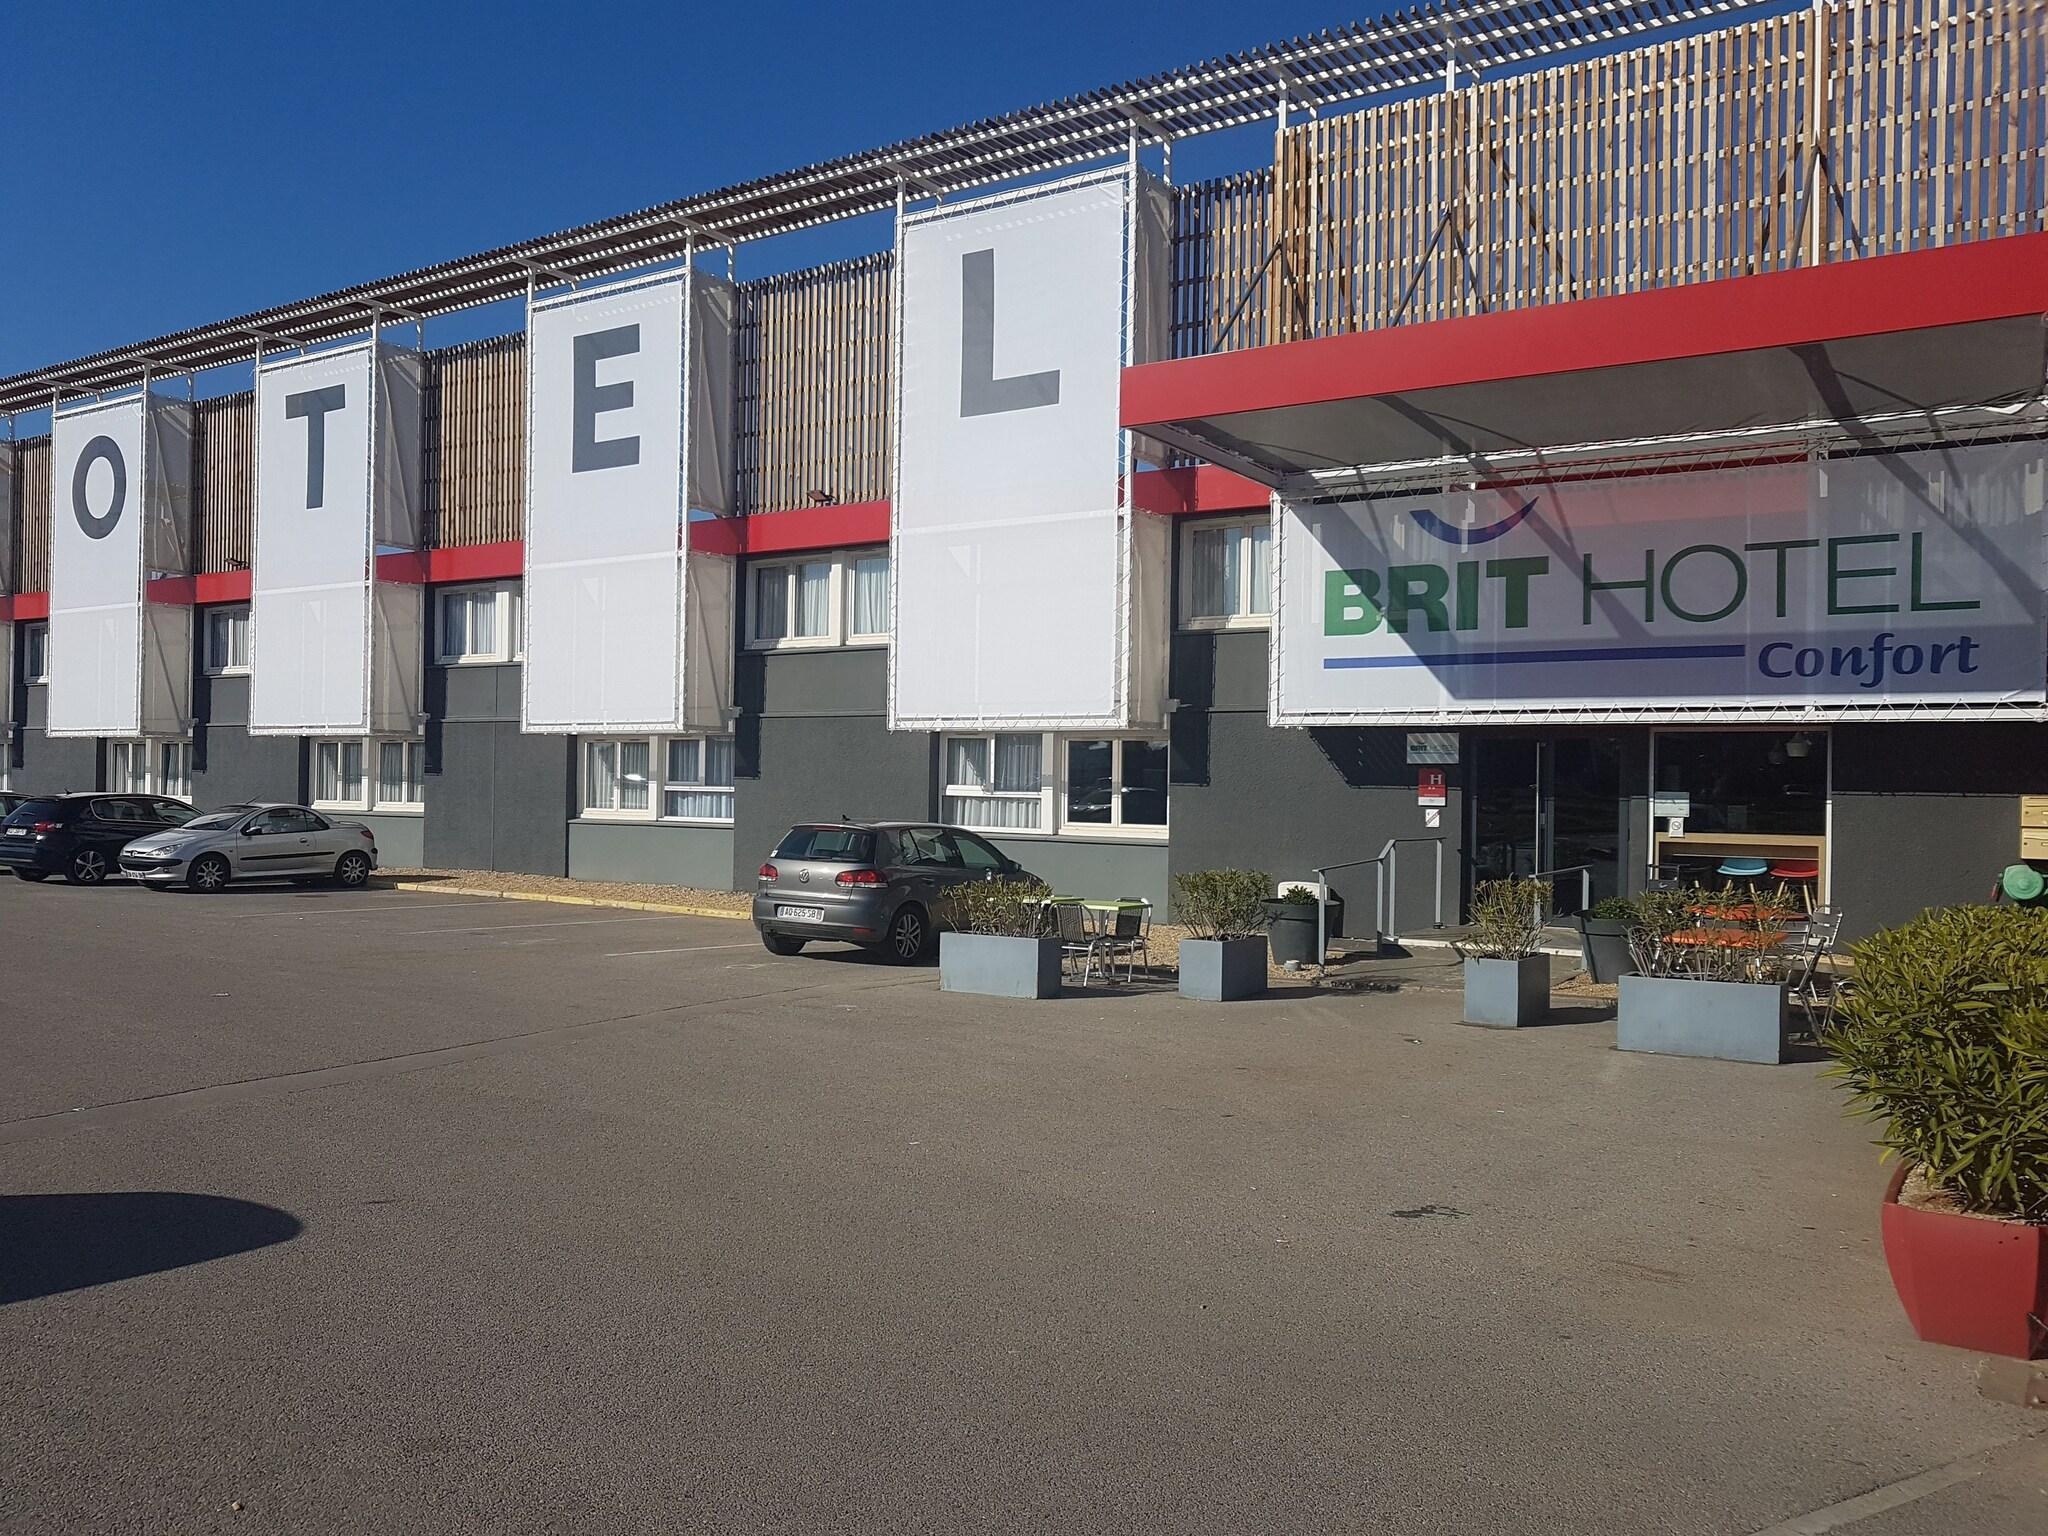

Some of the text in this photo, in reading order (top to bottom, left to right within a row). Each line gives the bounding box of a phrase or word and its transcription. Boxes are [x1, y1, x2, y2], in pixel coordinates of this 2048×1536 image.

[960, 248, 1060, 417] L
[285, 384, 346, 510] T
[572, 322, 640, 474] E
[72, 434, 127, 539] O
[1323, 532, 1980, 637] BRIT HOTEL
[1758, 632, 1980, 688] Confort
[1430, 774, 1442, 785] H
